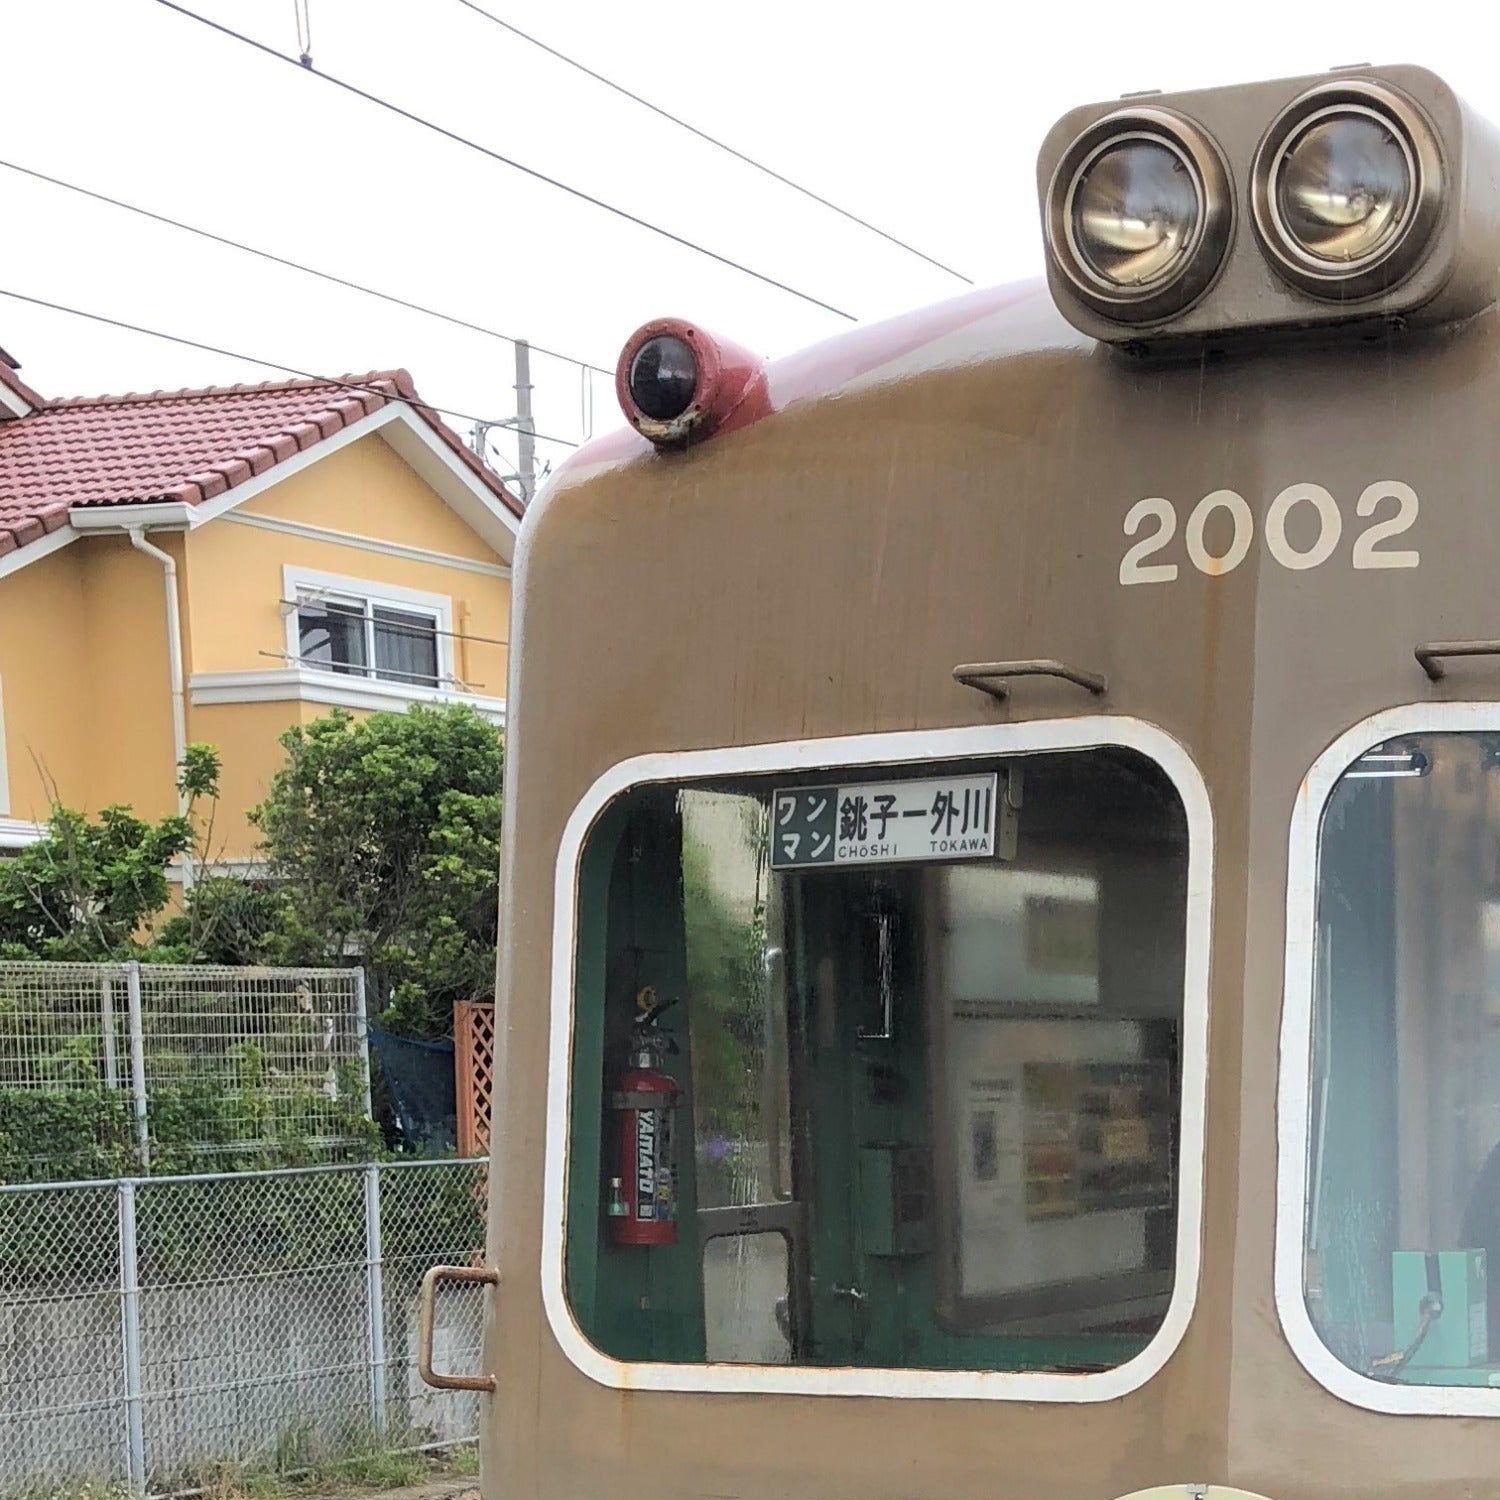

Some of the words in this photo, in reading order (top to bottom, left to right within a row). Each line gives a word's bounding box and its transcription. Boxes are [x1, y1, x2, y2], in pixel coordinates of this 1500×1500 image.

[1119, 480, 1420, 585] 20002
[778, 795, 828, 827] ワン
[781, 831, 832, 860] マン
[930, 837, 988, 853] TOKAWA
[638, 1109, 655, 1194] YAMATO
